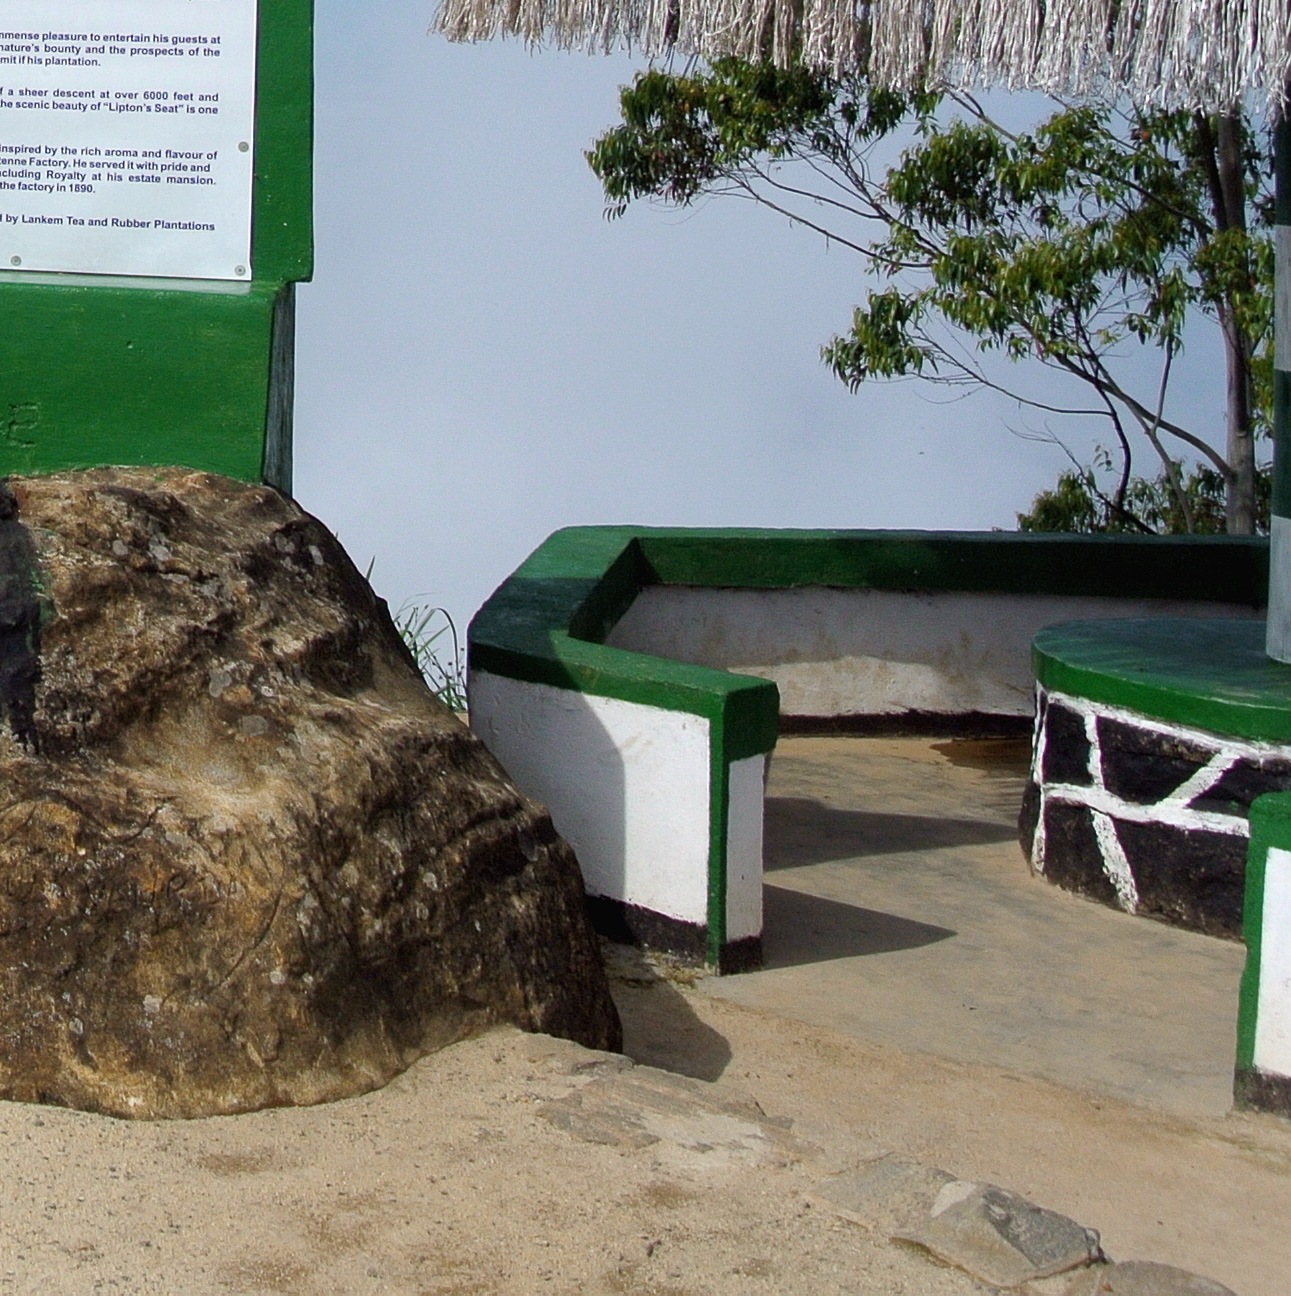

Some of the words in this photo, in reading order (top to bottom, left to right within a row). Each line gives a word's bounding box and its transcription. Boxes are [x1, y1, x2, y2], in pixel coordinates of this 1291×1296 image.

[41, 31, 87, 43] pleasure
[89, 33, 100, 41] to
[102, 32, 150, 42] entertain
[152, 33, 169, 43] his
[171, 35, 208, 46] guests
[210, 36, 220, 44] at
[44, 43, 81, 55] bounty
[85, 44, 105, 54] and
[109, 45, 125, 54] the
[130, 46, 183, 58] prospects
[188, 46, 199, 56] of
[203, 47, 220, 56] the
[18, 54, 25, 64] if
[27, 55, 42, 64] his
[44, 56, 100, 68] plantation.
[18, 86, 48, 97] sheer
[52, 88, 95, 98] descent
[99, 90, 109, 99] at
[114, 91, 138, 99] over
[143, 90, 168, 100] 6000
[173, 91, 193, 101] feet
[198, 92, 218, 101] and
[44, 144, 57, 157] by
[60, 145, 77, 155] the
[80, 146, 101, 156] rich
[104, 149, 138, 157] aroma
[141, 148, 161, 158] and
[165, 149, 203, 159] flavour
[206, 150, 217, 160] of
[28, 156, 71, 169] Factory.
[72, 158, 87, 168] He
[89, 159, 125, 169] served
[127, 160, 133, 169] it
[135, 160, 158, 170] with
[160, 161, 188, 173] pride
[190, 162, 210, 172] and
[46, 169, 86, 182] Royalty
[46, 169, 86, 182] at
[106, 171, 122, 182] his
[128, 173, 161, 182] estate
[166, 174, 216, 185] mansion.
[0, 180, 15, 190] the
[17, 181, 54, 193] factory
[56, 182, 66, 192] in
[69, 183, 95, 193] 1890.
[5, 213, 18, 225] by
[21, 214, 63, 224] Lankem
[66, 215, 84, 225] Tea
[88, 217, 108, 226] and
[111, 217, 151, 228] Rubber
[154, 219, 215, 230] Plantations
